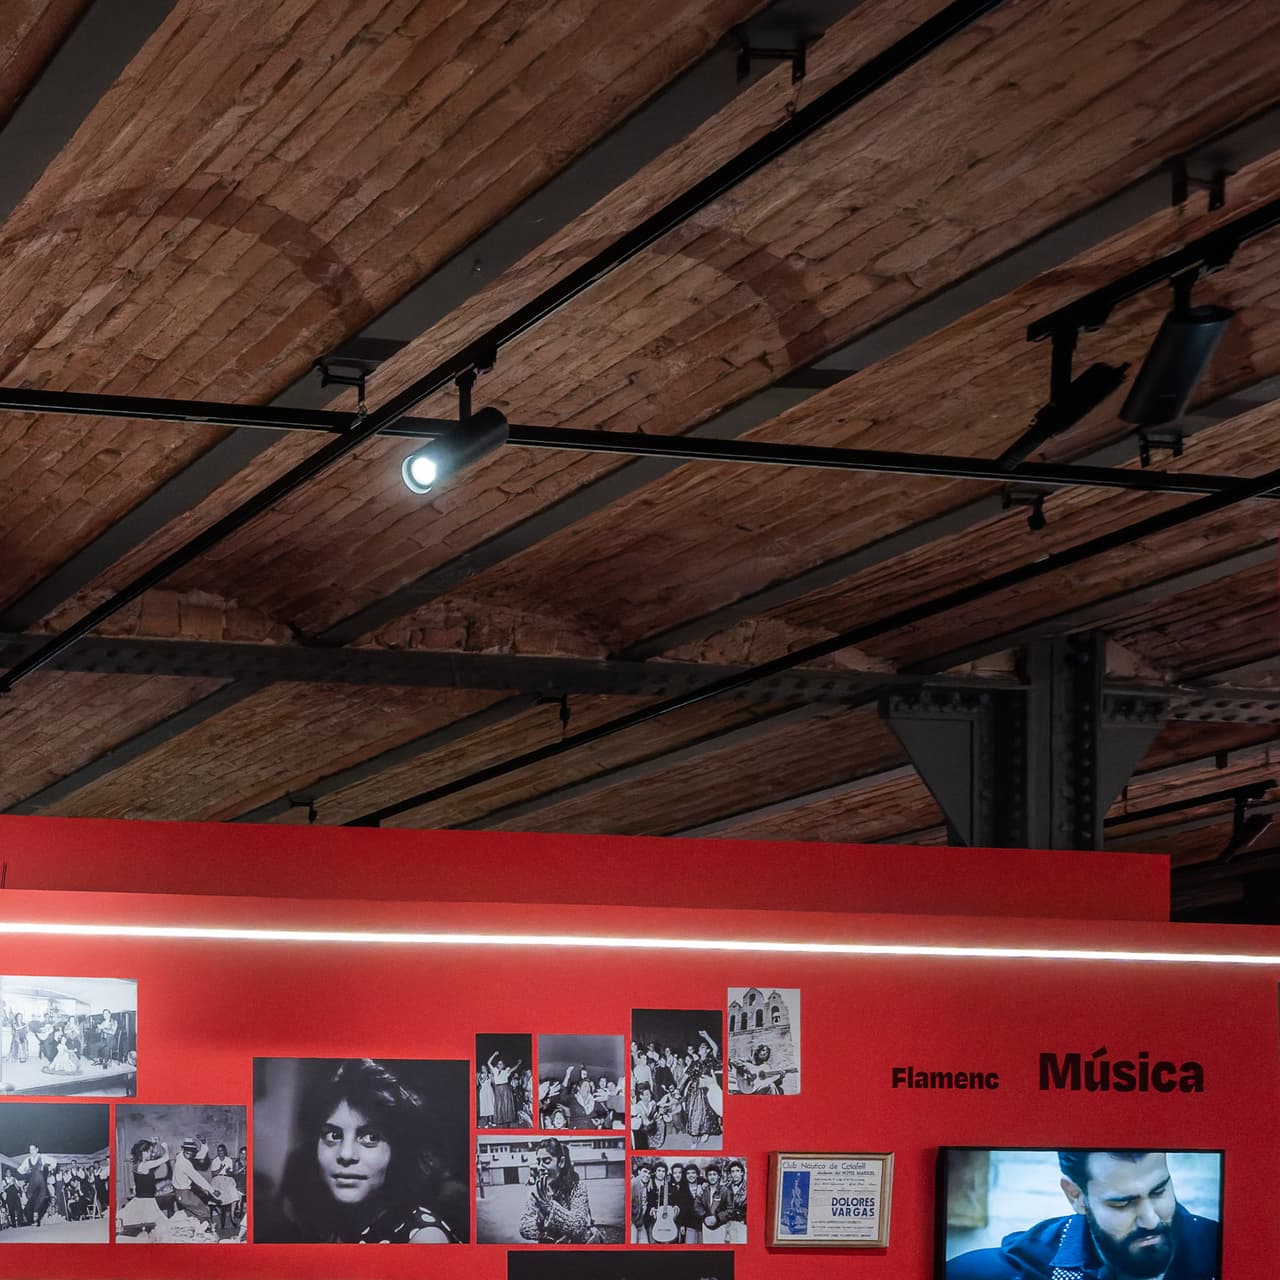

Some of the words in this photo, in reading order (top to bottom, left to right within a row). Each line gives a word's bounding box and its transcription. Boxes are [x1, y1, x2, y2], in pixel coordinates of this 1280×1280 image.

[1039, 1046, 1204, 1092] Música
[891, 1066, 999, 1089] Flamenc
[782, 1161, 797, 1169] Club
[829, 1161, 838, 1169] de
[831, 1197, 875, 1207] DOLORES
[831, 1207, 875, 1217] VARGAS
